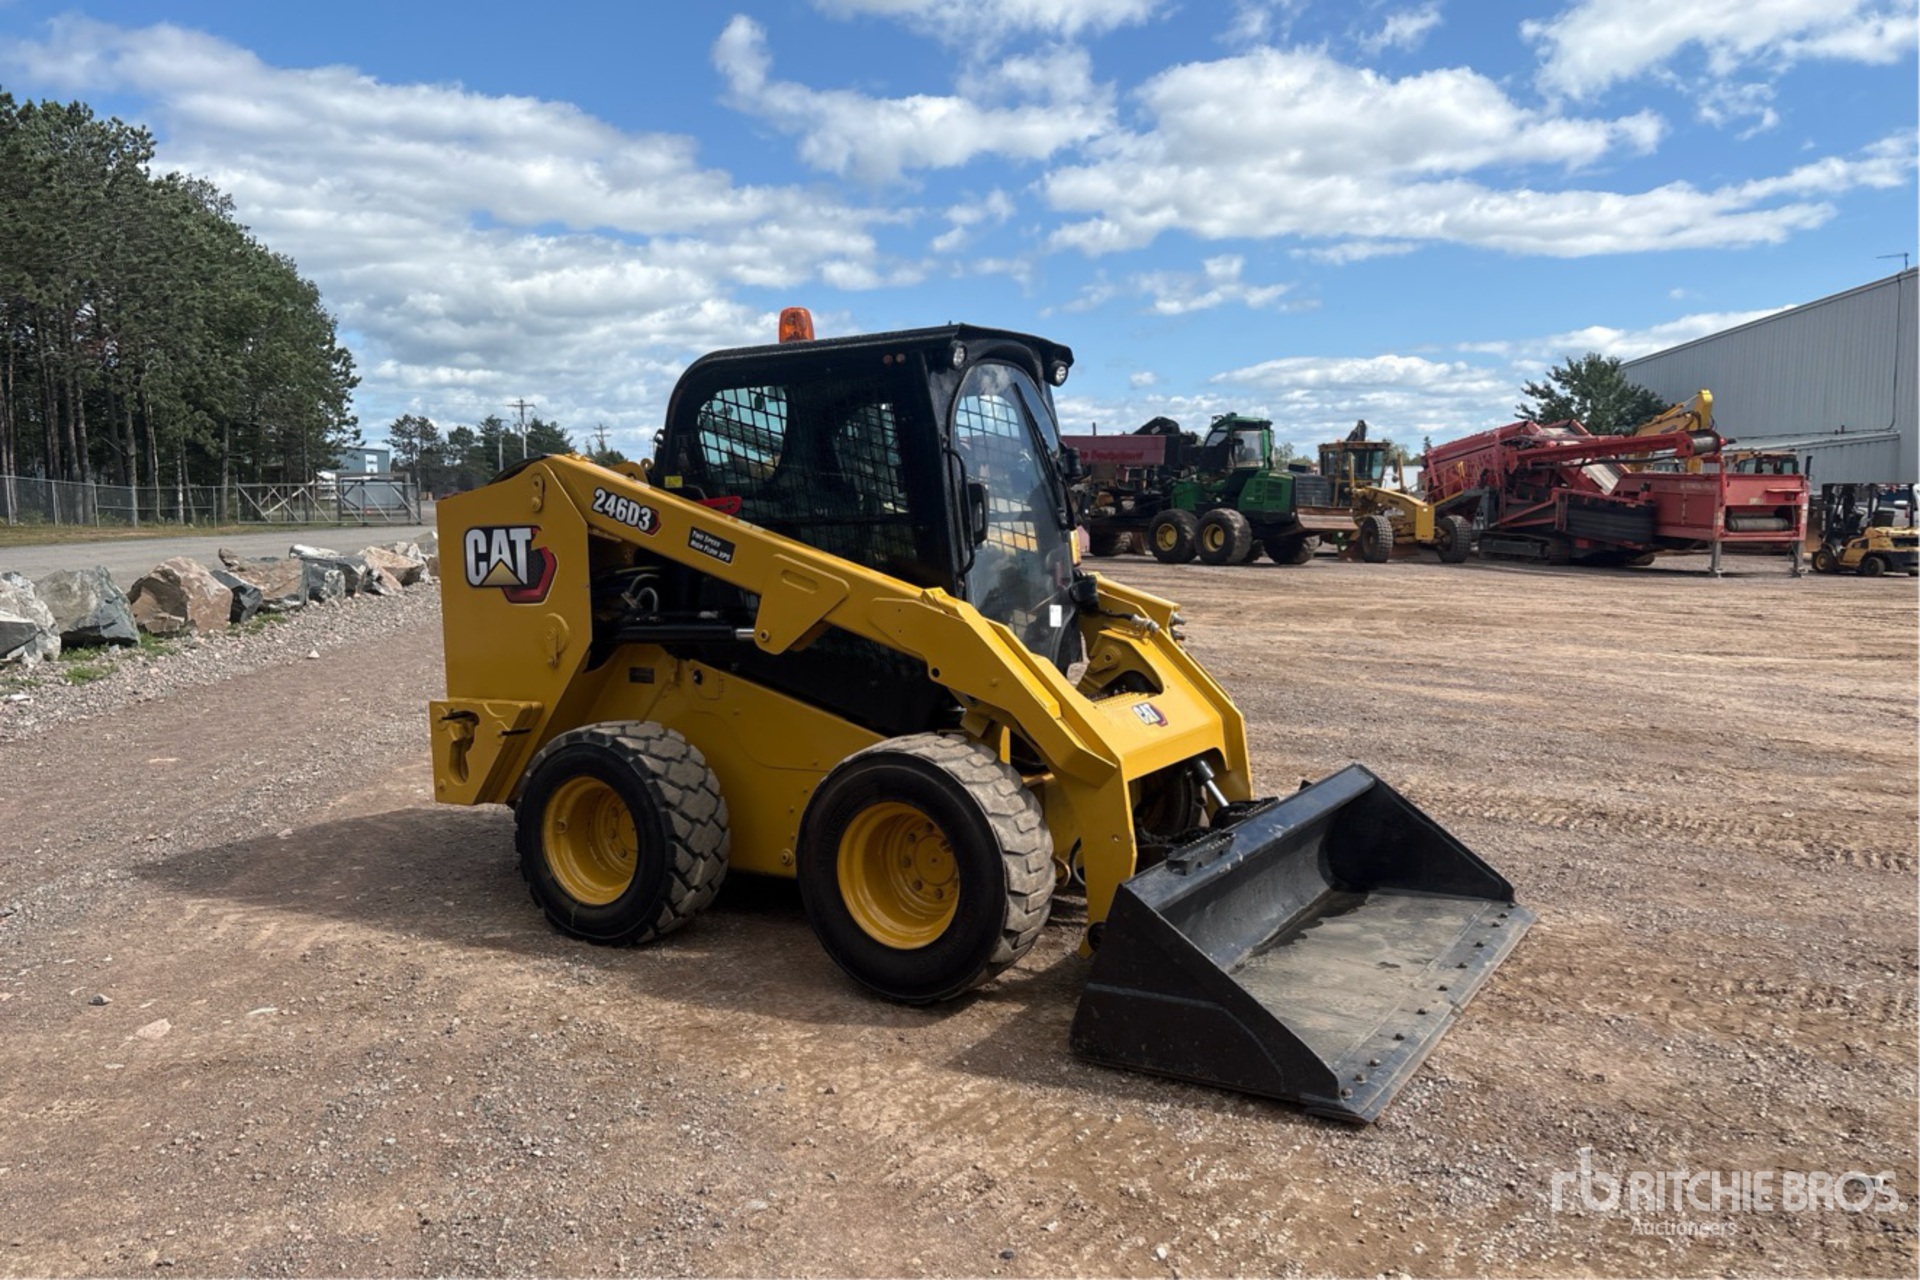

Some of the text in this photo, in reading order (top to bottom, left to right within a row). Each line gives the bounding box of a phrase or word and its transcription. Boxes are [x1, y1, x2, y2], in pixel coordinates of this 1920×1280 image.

[593, 488, 652, 531] 246D3
[465, 527, 532, 586] CAT
[718, 551, 731, 561] XPS
[1132, 703, 1160, 725] CAT
